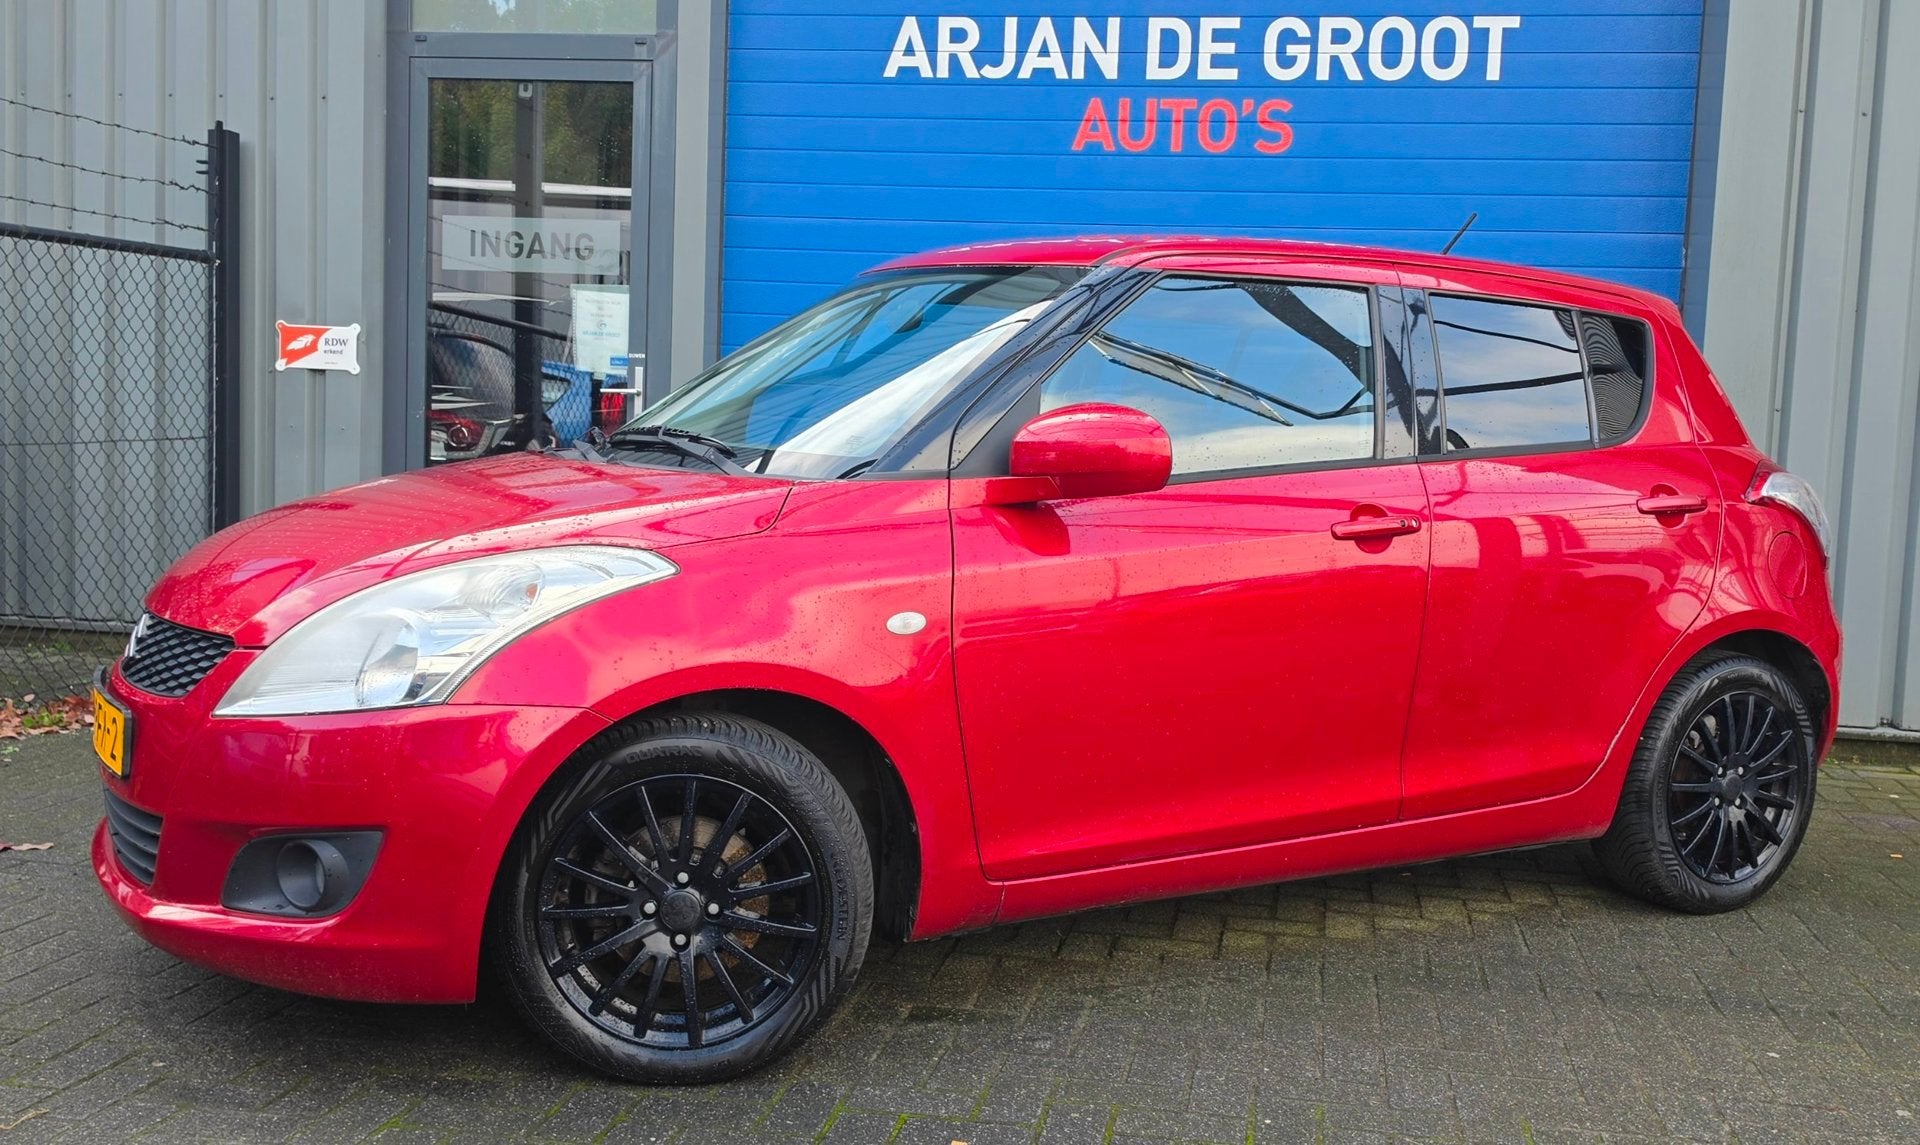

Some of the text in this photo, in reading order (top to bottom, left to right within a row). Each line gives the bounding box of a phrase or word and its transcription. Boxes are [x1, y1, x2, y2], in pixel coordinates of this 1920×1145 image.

[883, 15, 1521, 82] ARJAN DE GROOT
[1071, 98, 1294, 154] AUTO'S
[469, 229, 595, 261] INGANG
[324, 337, 349, 347] RDW
